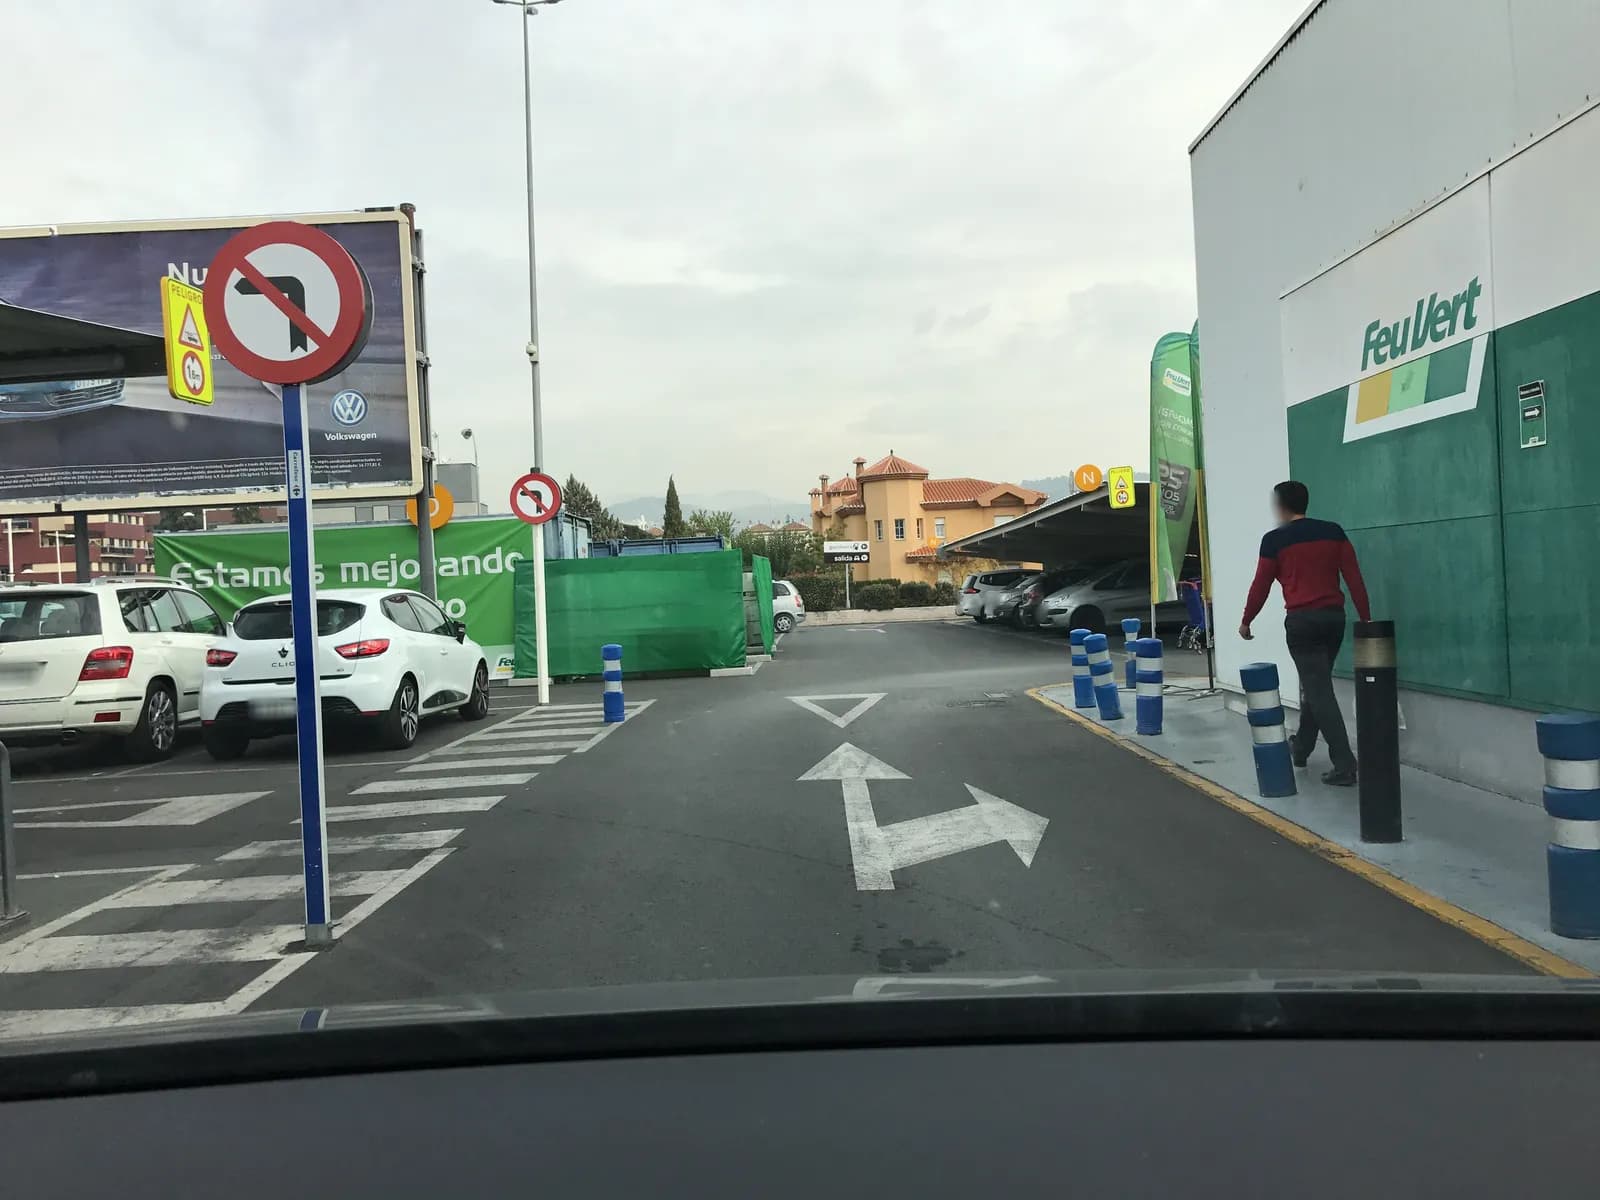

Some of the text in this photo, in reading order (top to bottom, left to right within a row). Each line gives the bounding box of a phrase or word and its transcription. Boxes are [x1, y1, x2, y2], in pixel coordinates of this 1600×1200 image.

[324, 432, 377, 441] Volkswagen
[1083, 472, 1095, 485] N
[340, 547, 524, 587] mejoando
